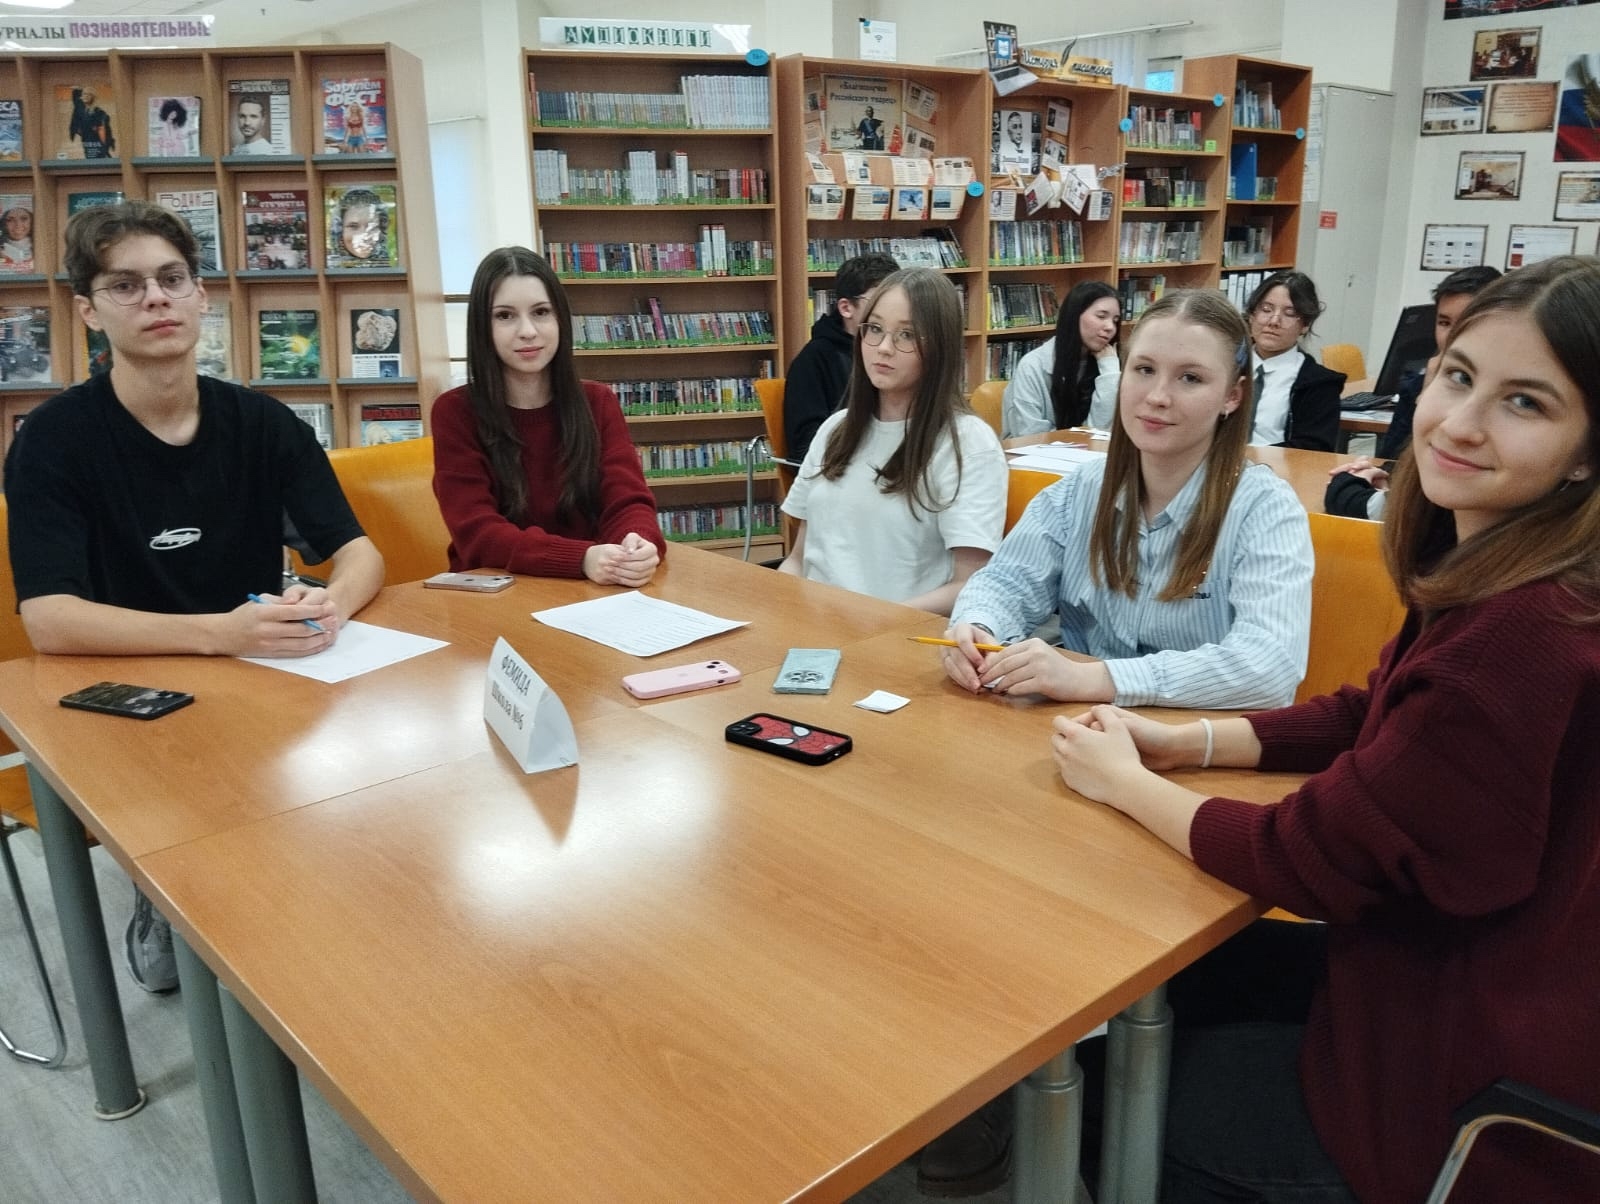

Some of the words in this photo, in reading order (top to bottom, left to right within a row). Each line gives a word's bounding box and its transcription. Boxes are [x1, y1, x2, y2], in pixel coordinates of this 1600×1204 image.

[564, 25, 712, 47] АУДИОКНИГИ
[501, 654, 532, 696] ФЕМИДА
[491, 680, 512, 716] Школа
